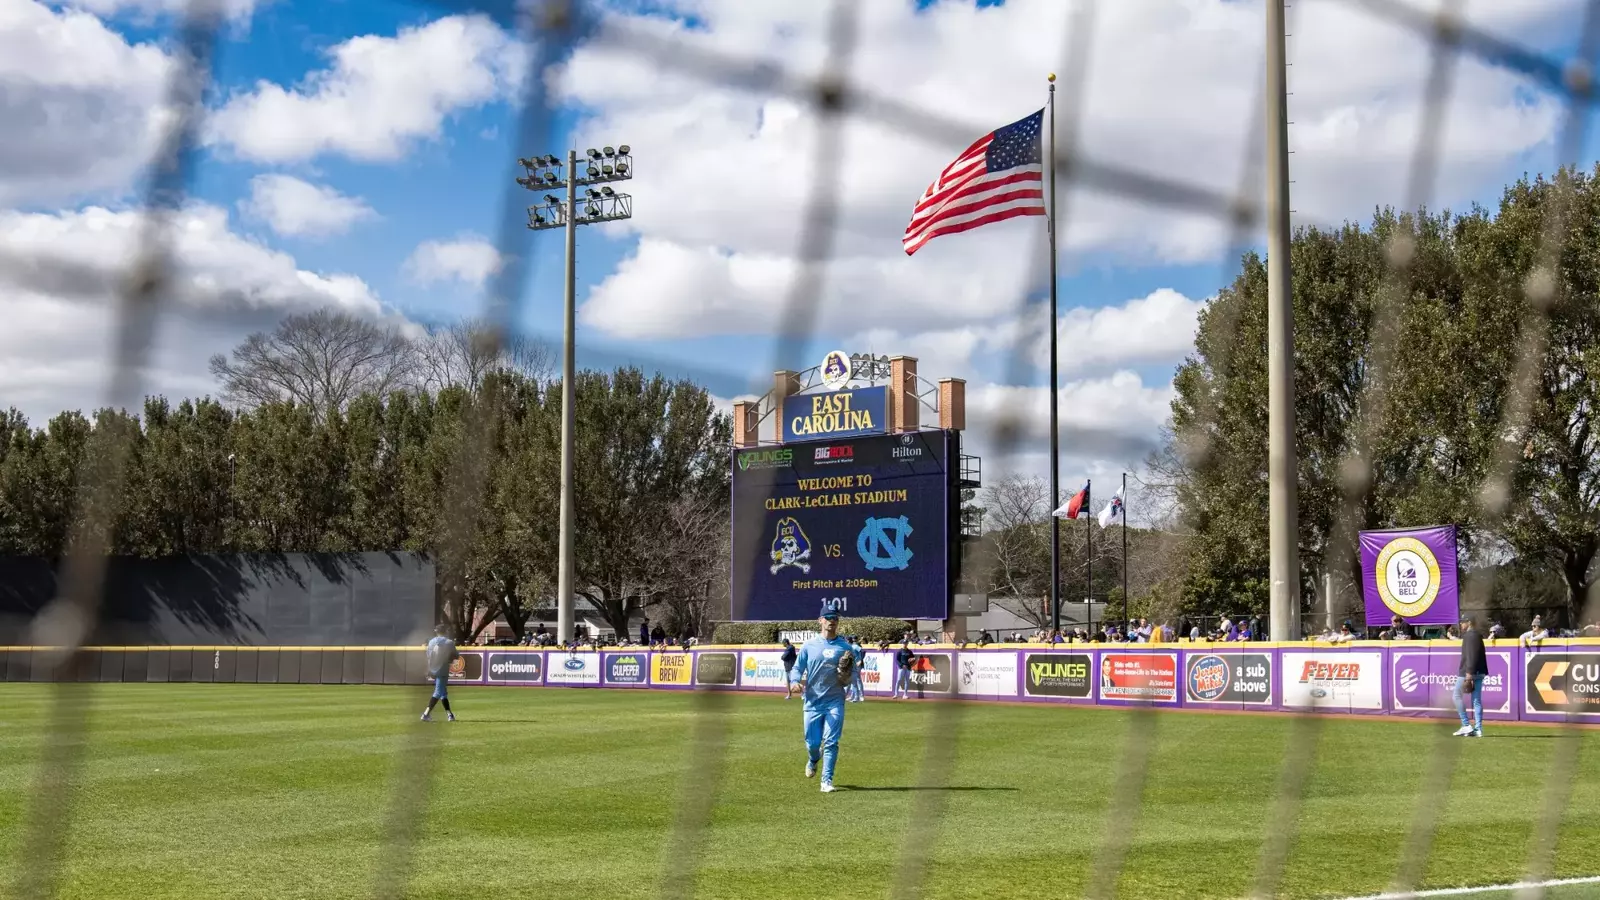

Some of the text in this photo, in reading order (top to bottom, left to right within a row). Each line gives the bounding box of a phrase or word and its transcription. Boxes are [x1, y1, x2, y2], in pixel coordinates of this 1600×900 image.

[812, 392, 853, 415] EAST
[791, 409, 874, 436] CAROLINA
[892, 446, 922, 458] Hilton
[738, 449, 793, 471] YOUNGS
[798, 474, 872, 491] WELCOME TO
[765, 489, 908, 510] CLARK-LeCLAIR STADIUM
[781, 526, 795, 536] ECU
[792, 578, 878, 589] First Pitch at 2:05pm
[1397, 580, 1418, 588] TACO
[1399, 588, 1418, 596] BELL
[660, 655, 685, 667] PIRATES
[612, 664, 640, 676] CULPEPER
[659, 667, 678, 682] BREW
[757, 666, 785, 681] Lottery
[926, 670, 942, 684] Hut
[1030, 662, 1087, 687] YOUNGS
[1194, 663, 1224, 680] Jersey
[1236, 663, 1266, 677] a sub
[1299, 660, 1361, 682] FEYER
[1420, 673, 1503, 687] orthopae ast
